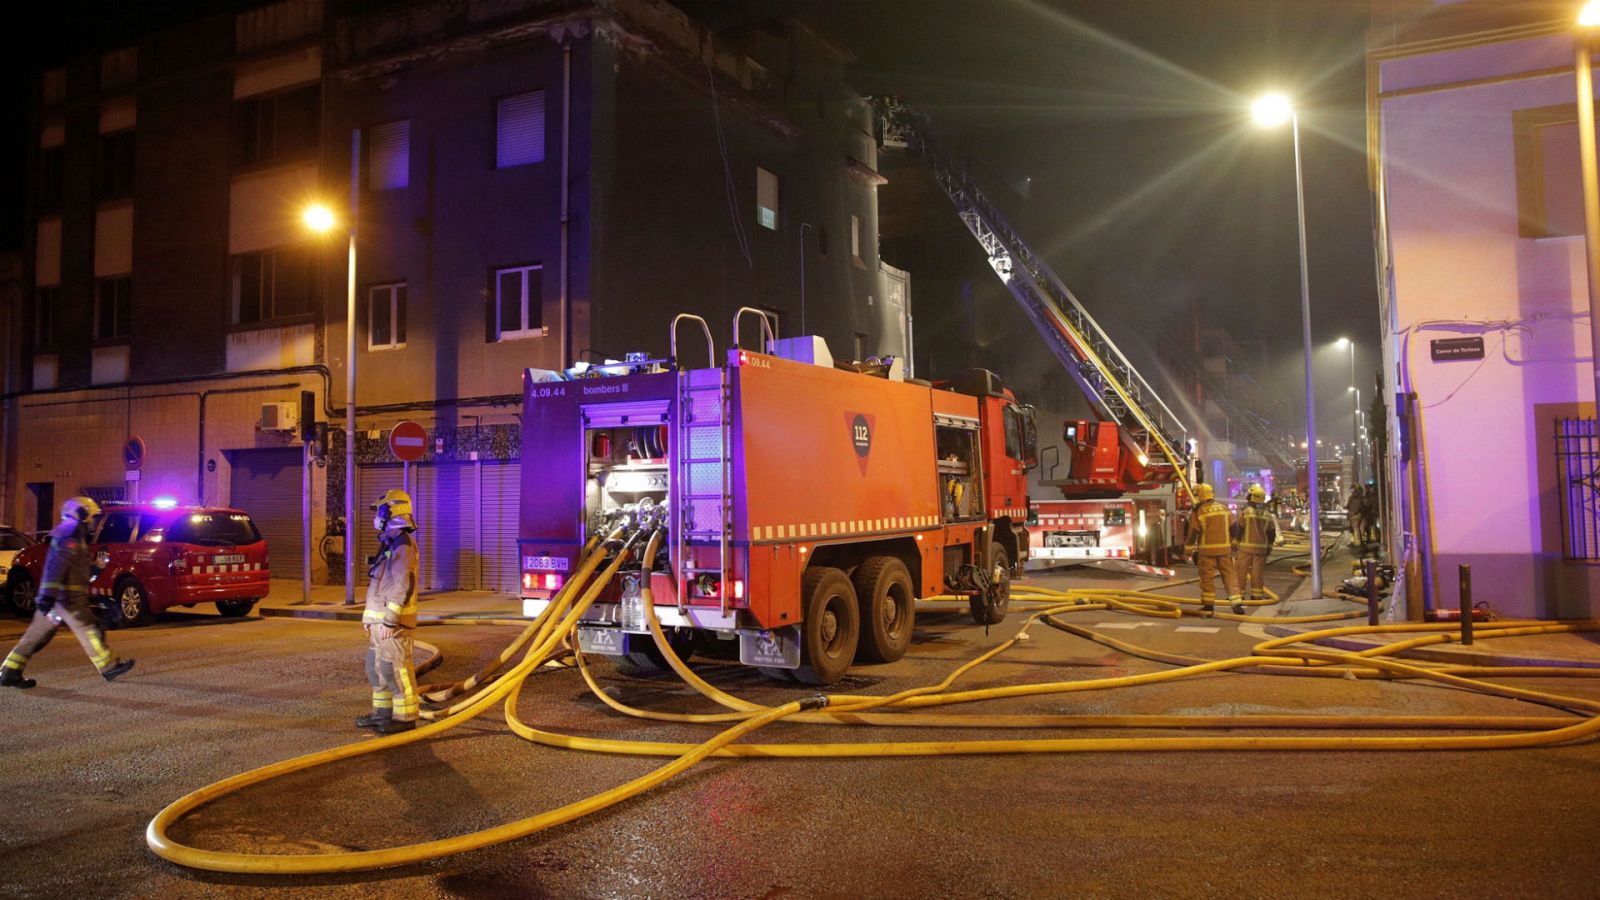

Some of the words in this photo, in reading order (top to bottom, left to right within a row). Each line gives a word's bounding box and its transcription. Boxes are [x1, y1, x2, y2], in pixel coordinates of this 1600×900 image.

[531, 387, 566, 397] 4.09.44
[583, 384, 620, 395] bombers
[854, 425, 868, 441] 112
[529, 558, 549, 569] 2063
